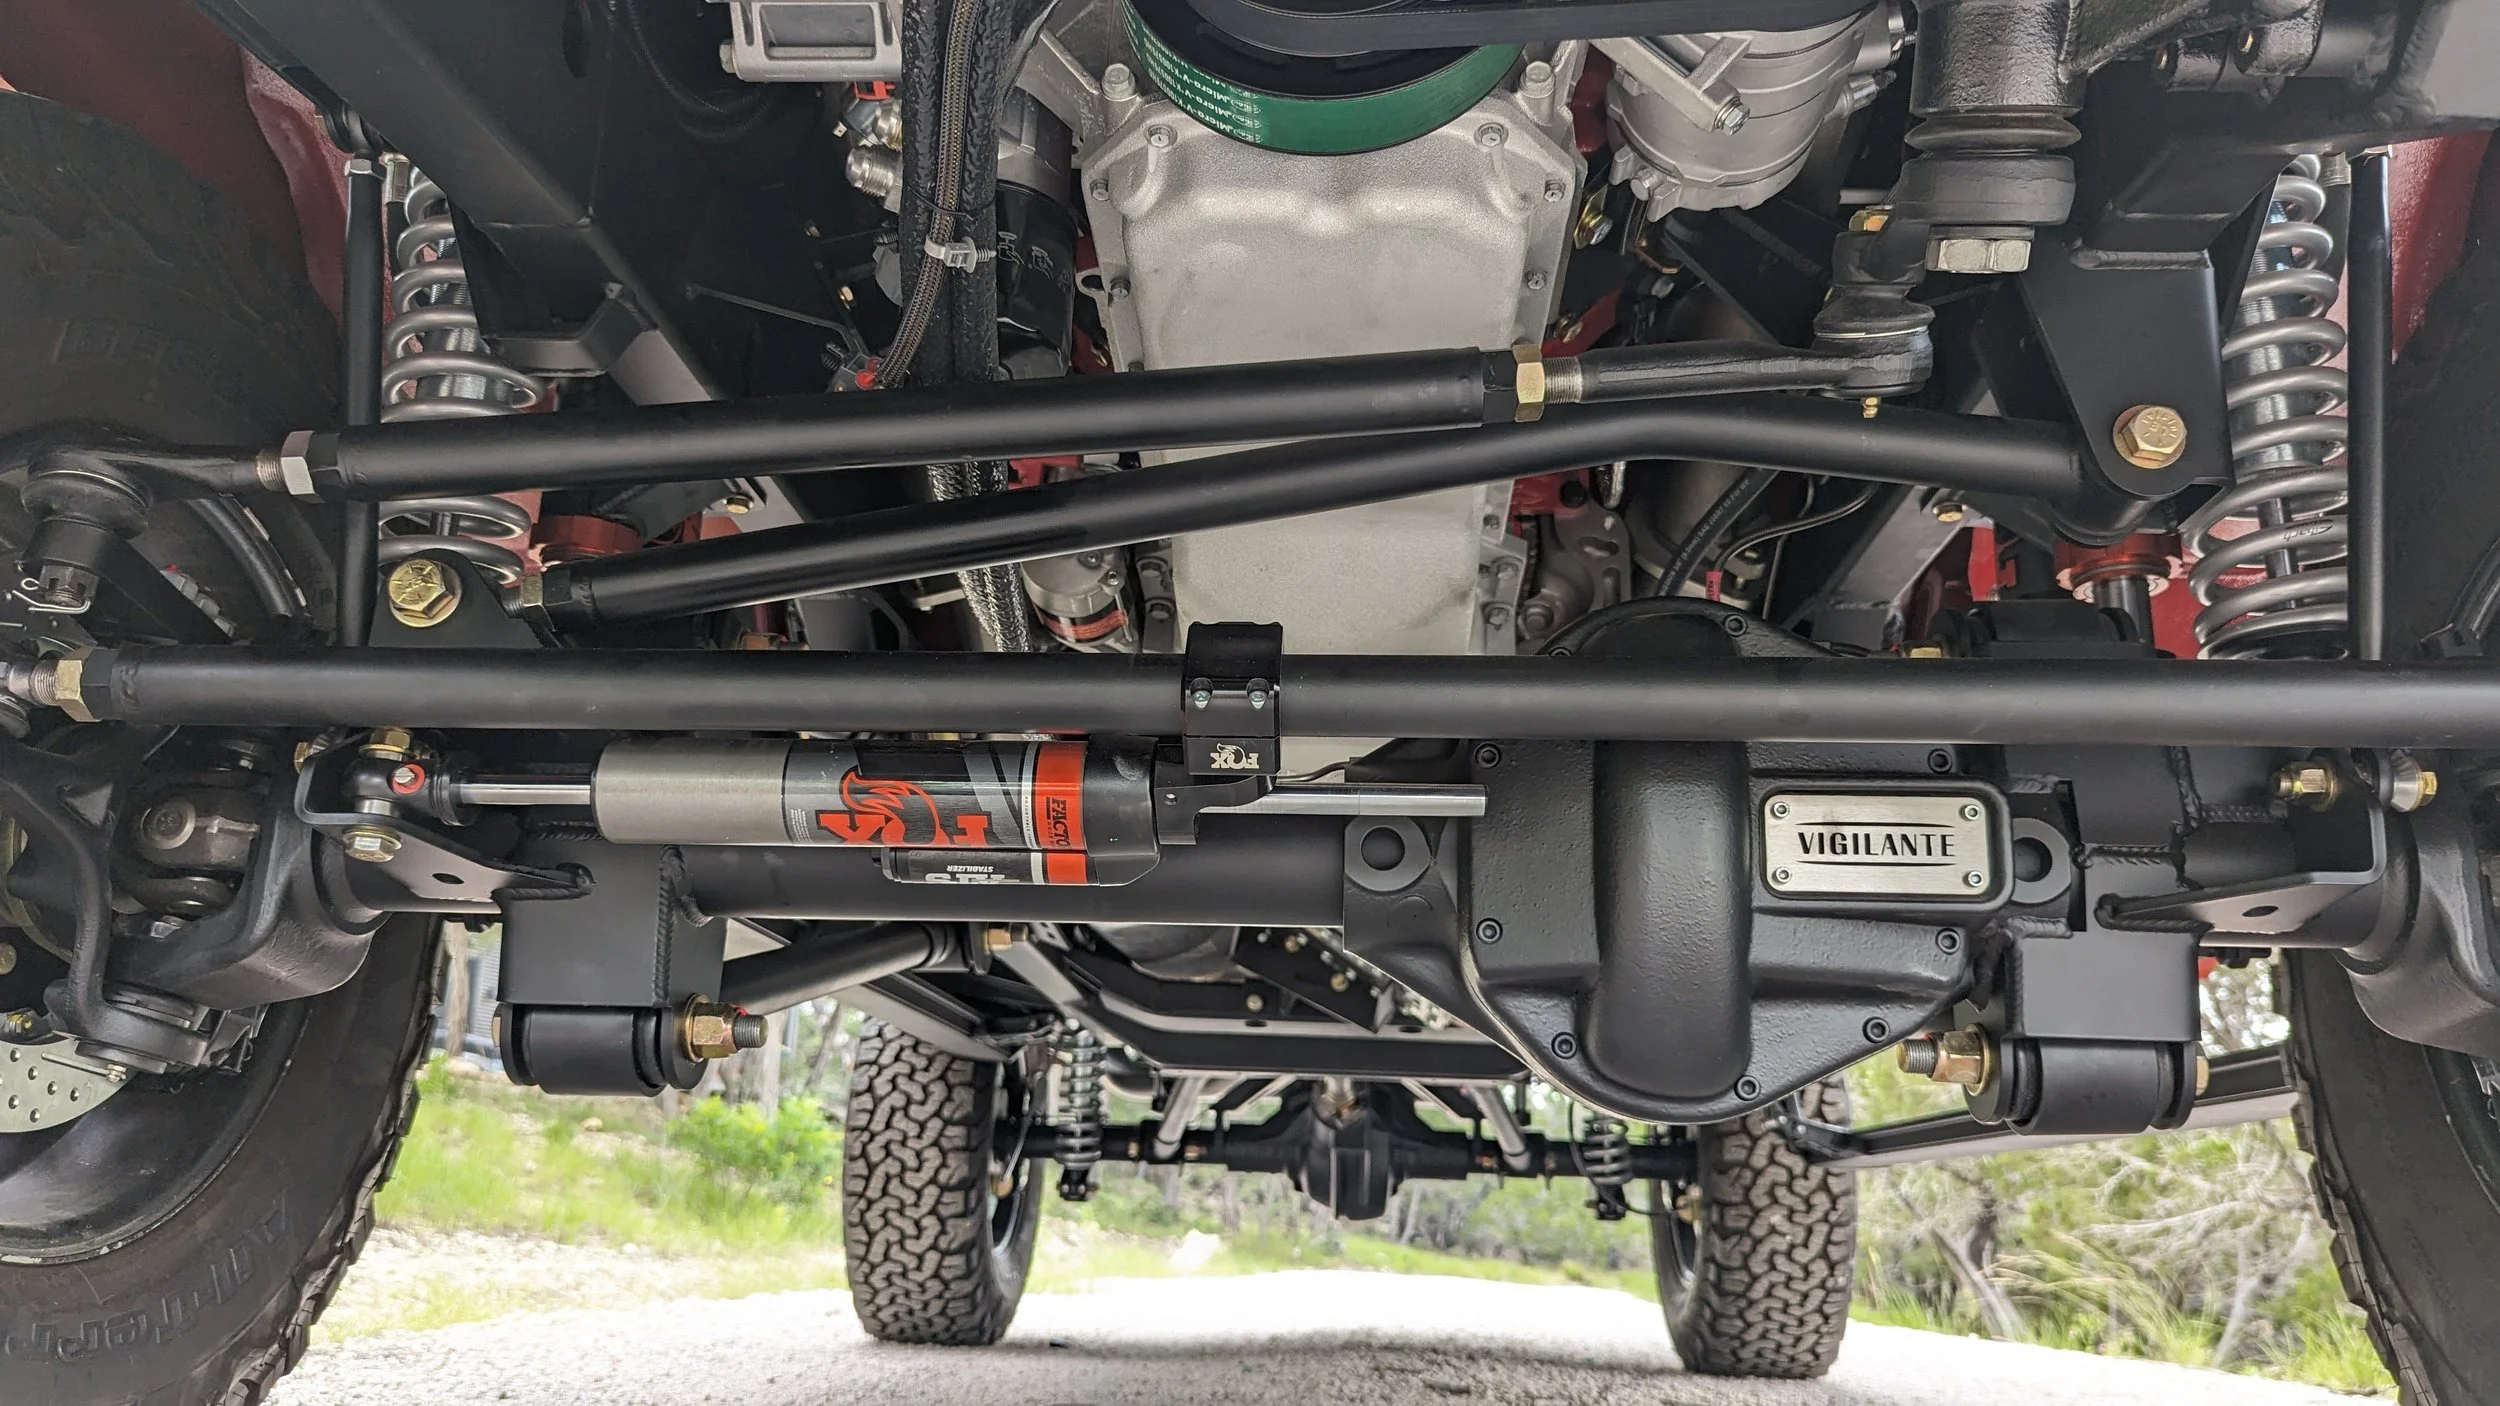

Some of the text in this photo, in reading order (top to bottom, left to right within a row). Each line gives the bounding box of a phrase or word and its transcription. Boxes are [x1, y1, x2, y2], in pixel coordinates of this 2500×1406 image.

[1184, 89, 1229, 118] Micro-V
[1186, 103, 1231, 133] Micro-V
[1210, 742, 1260, 769] FOX
[1052, 797, 1072, 849] FACTO
[1797, 832, 1956, 857] VIGILANTE
[946, 864, 994, 873] STABILIZER
